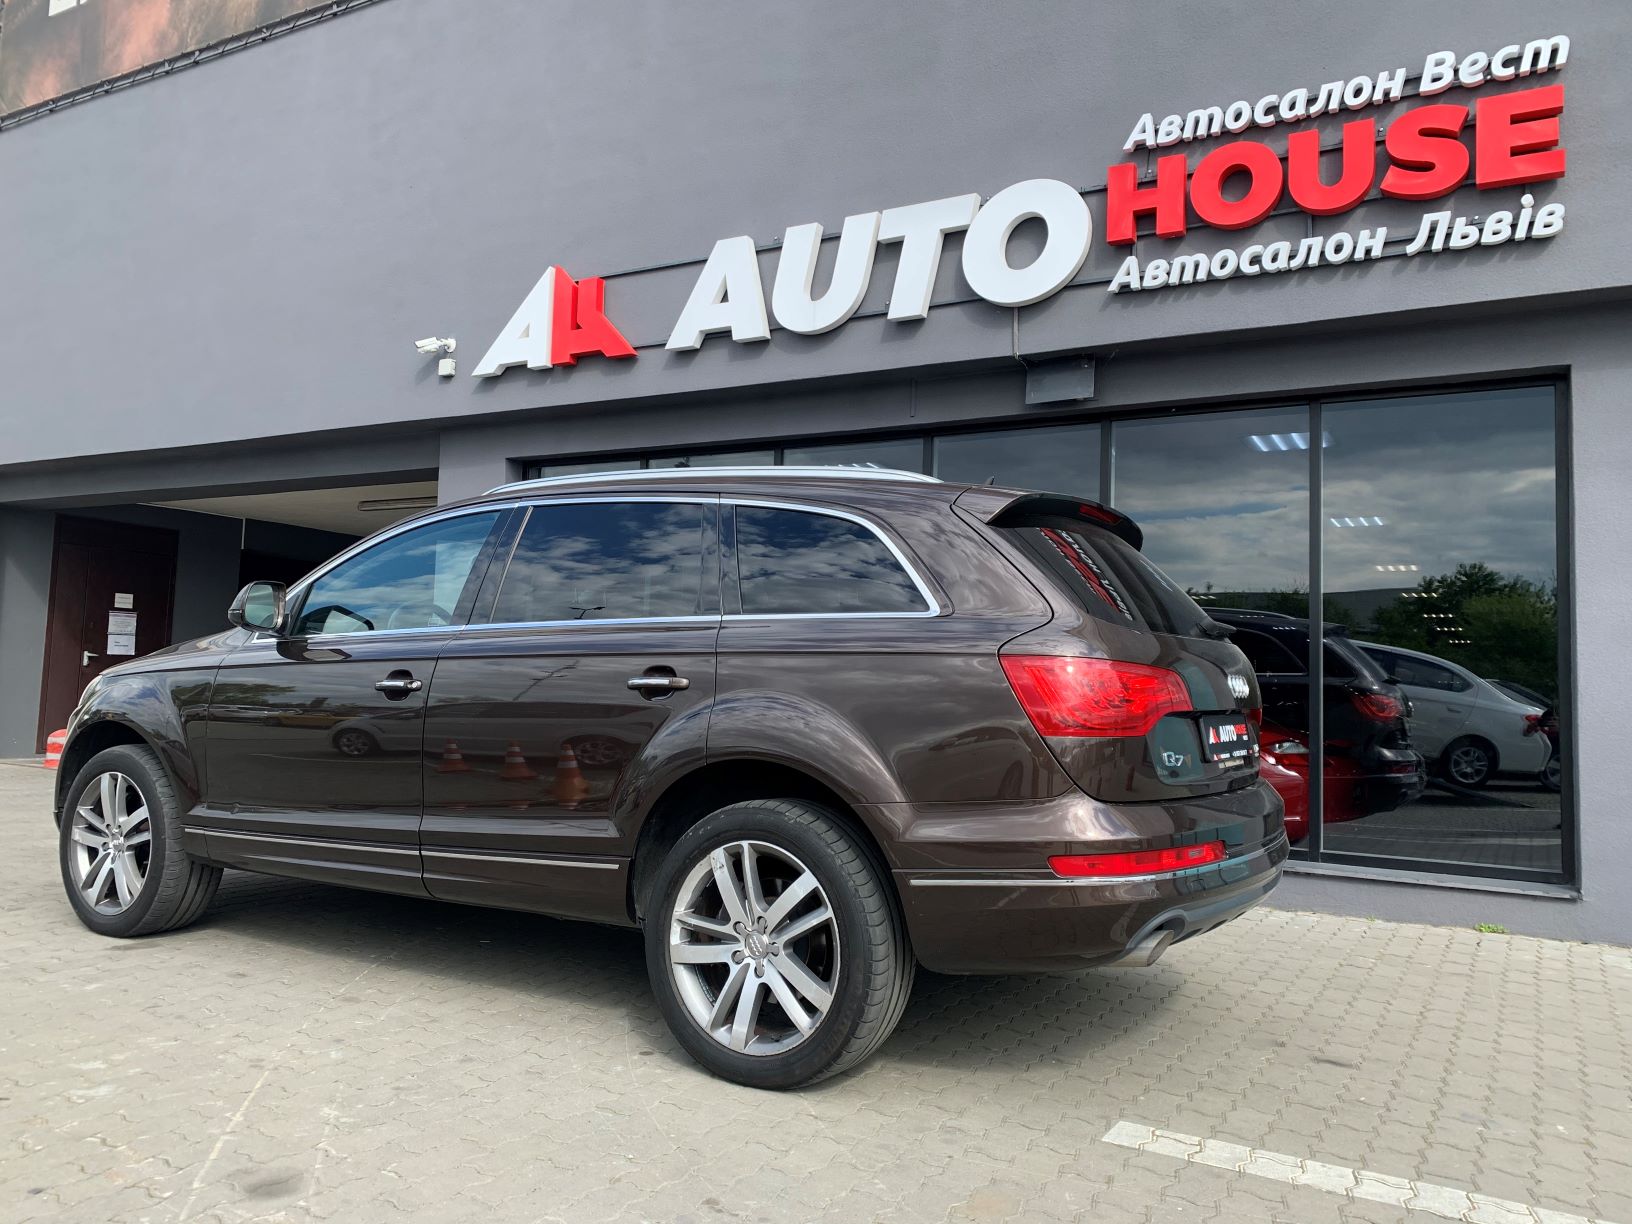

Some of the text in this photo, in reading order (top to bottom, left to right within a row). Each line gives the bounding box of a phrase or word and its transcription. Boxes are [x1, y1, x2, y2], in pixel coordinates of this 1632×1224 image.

[1123, 34, 1570, 152] Автосалон Вест
[665, 84, 1566, 351] AUTO HOUSE
[1107, 194, 1565, 293] Автосалон Львів
[1162, 751, 1184, 767] Q7
